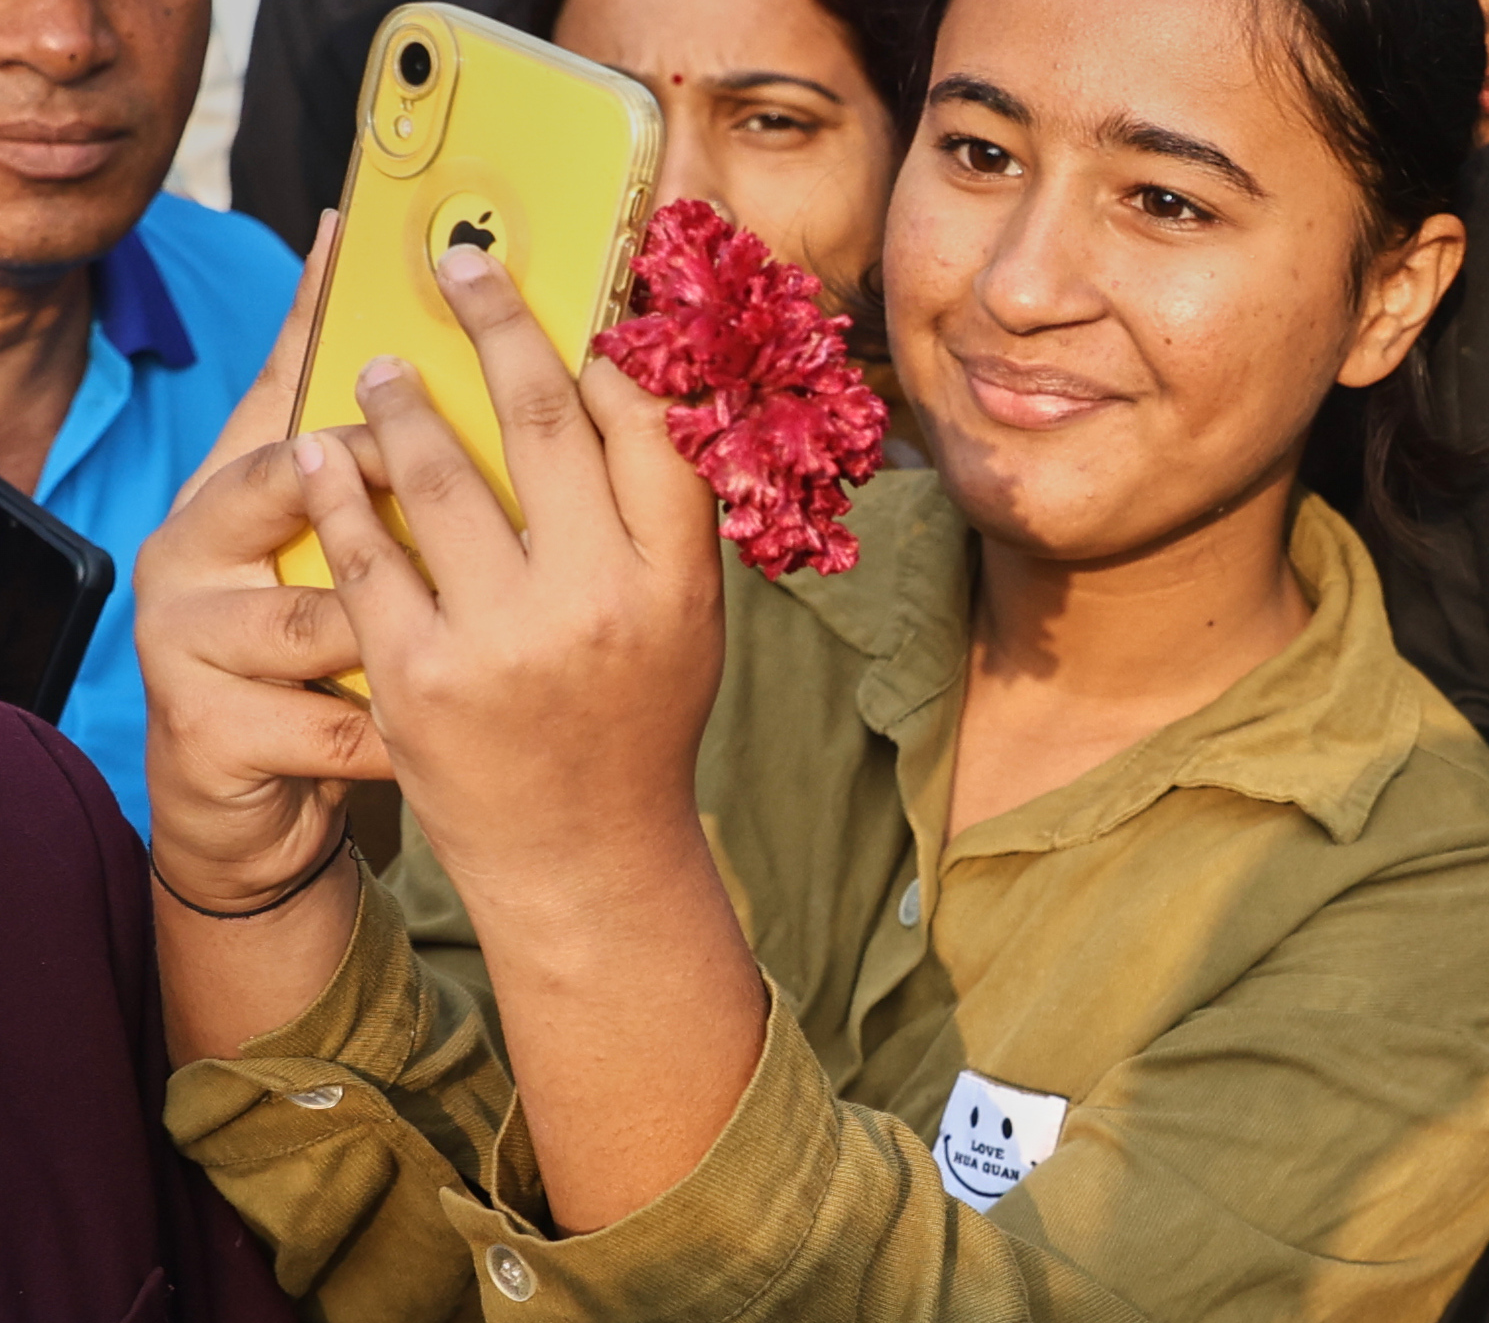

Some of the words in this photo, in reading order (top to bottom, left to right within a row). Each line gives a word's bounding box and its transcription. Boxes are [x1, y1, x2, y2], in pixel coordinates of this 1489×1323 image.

[971, 1140, 1005, 1160] LOVE
[953, 1152, 978, 1169] HUA
[982, 1161, 1020, 1181] QUAN
